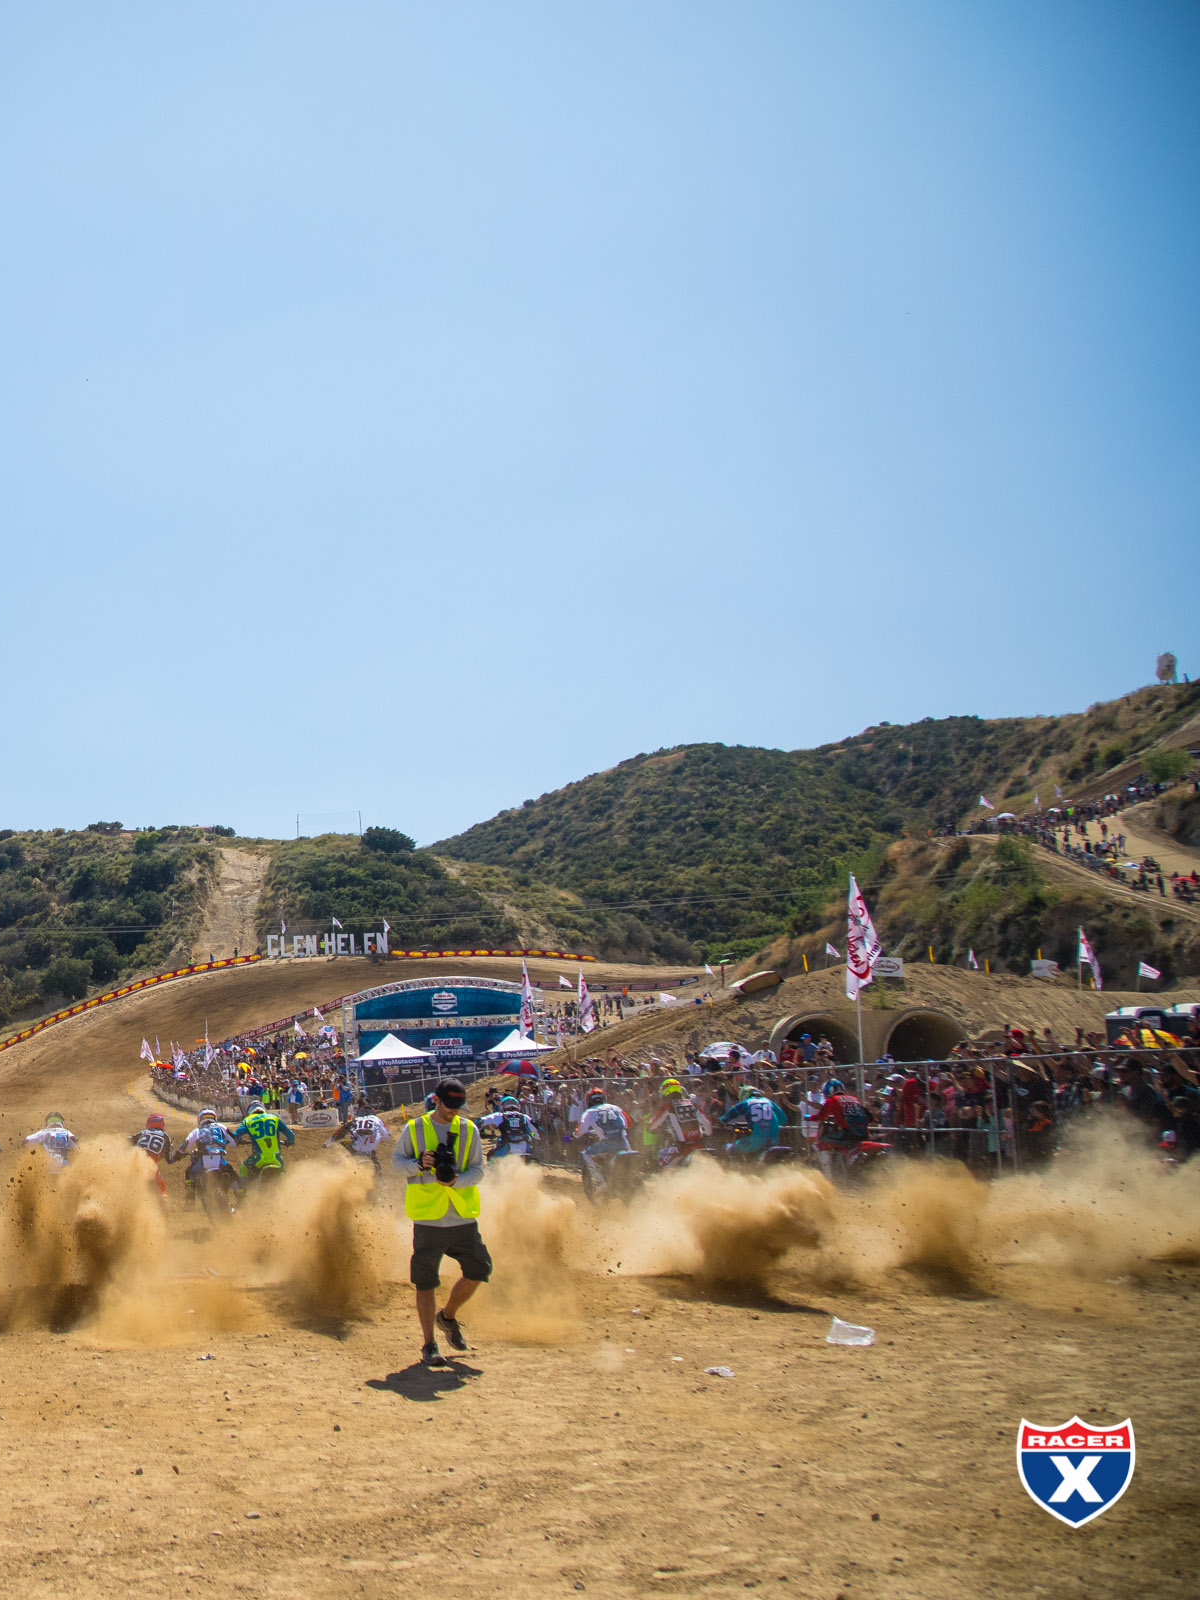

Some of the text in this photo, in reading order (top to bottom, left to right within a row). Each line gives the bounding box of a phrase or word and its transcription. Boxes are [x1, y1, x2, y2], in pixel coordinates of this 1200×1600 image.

[267, 932, 389, 958] GLEN HELEN
[427, 1048, 473, 1056] OTOCROSS
[377, 1058, 424, 1066] #ProMotocross
[750, 1103, 773, 1122] 50
[250, 1119, 276, 1139] 36
[137, 1133, 165, 1154] 26
